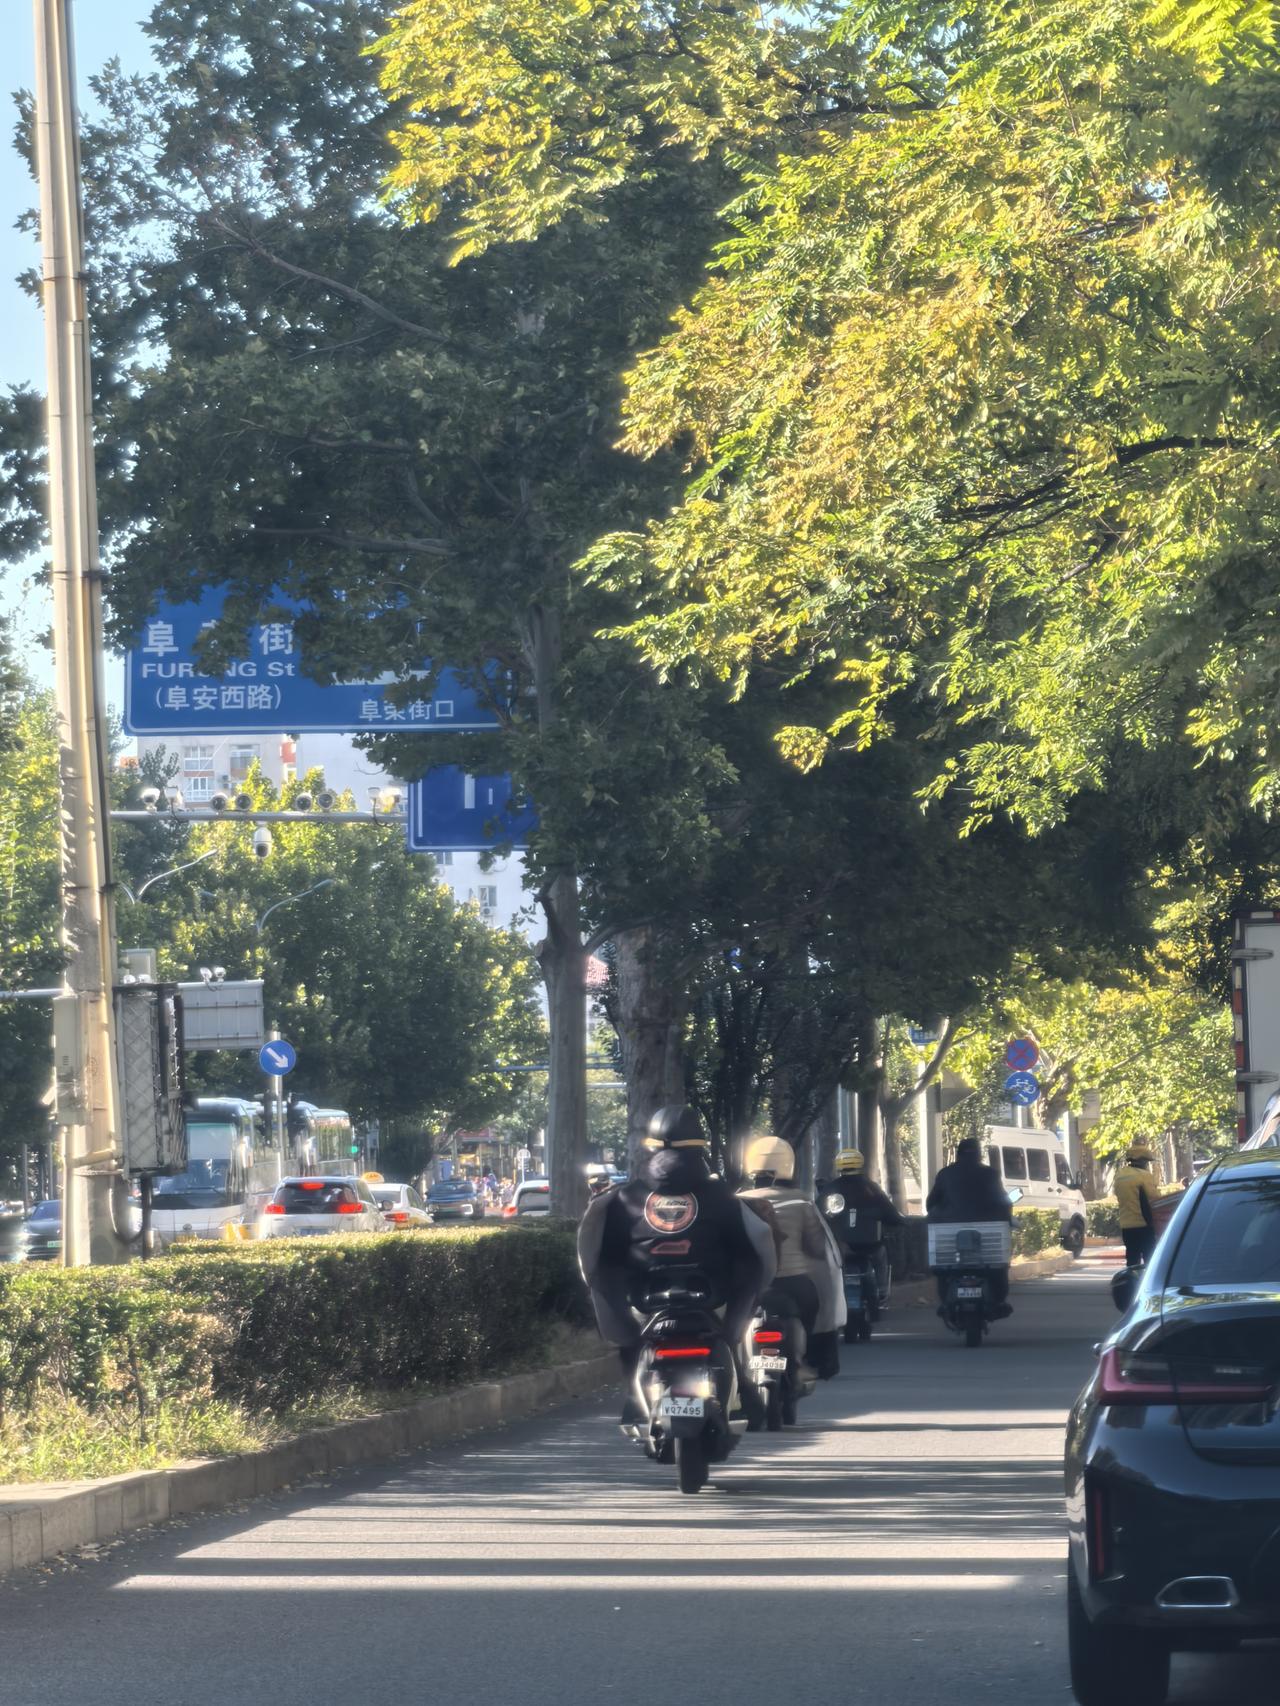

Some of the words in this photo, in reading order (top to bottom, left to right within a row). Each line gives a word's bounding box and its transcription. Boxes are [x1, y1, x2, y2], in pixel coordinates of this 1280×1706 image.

[143, 620, 295, 657] 阜街
[142, 661, 257, 678] FURNG
[267, 661, 295, 677] St
